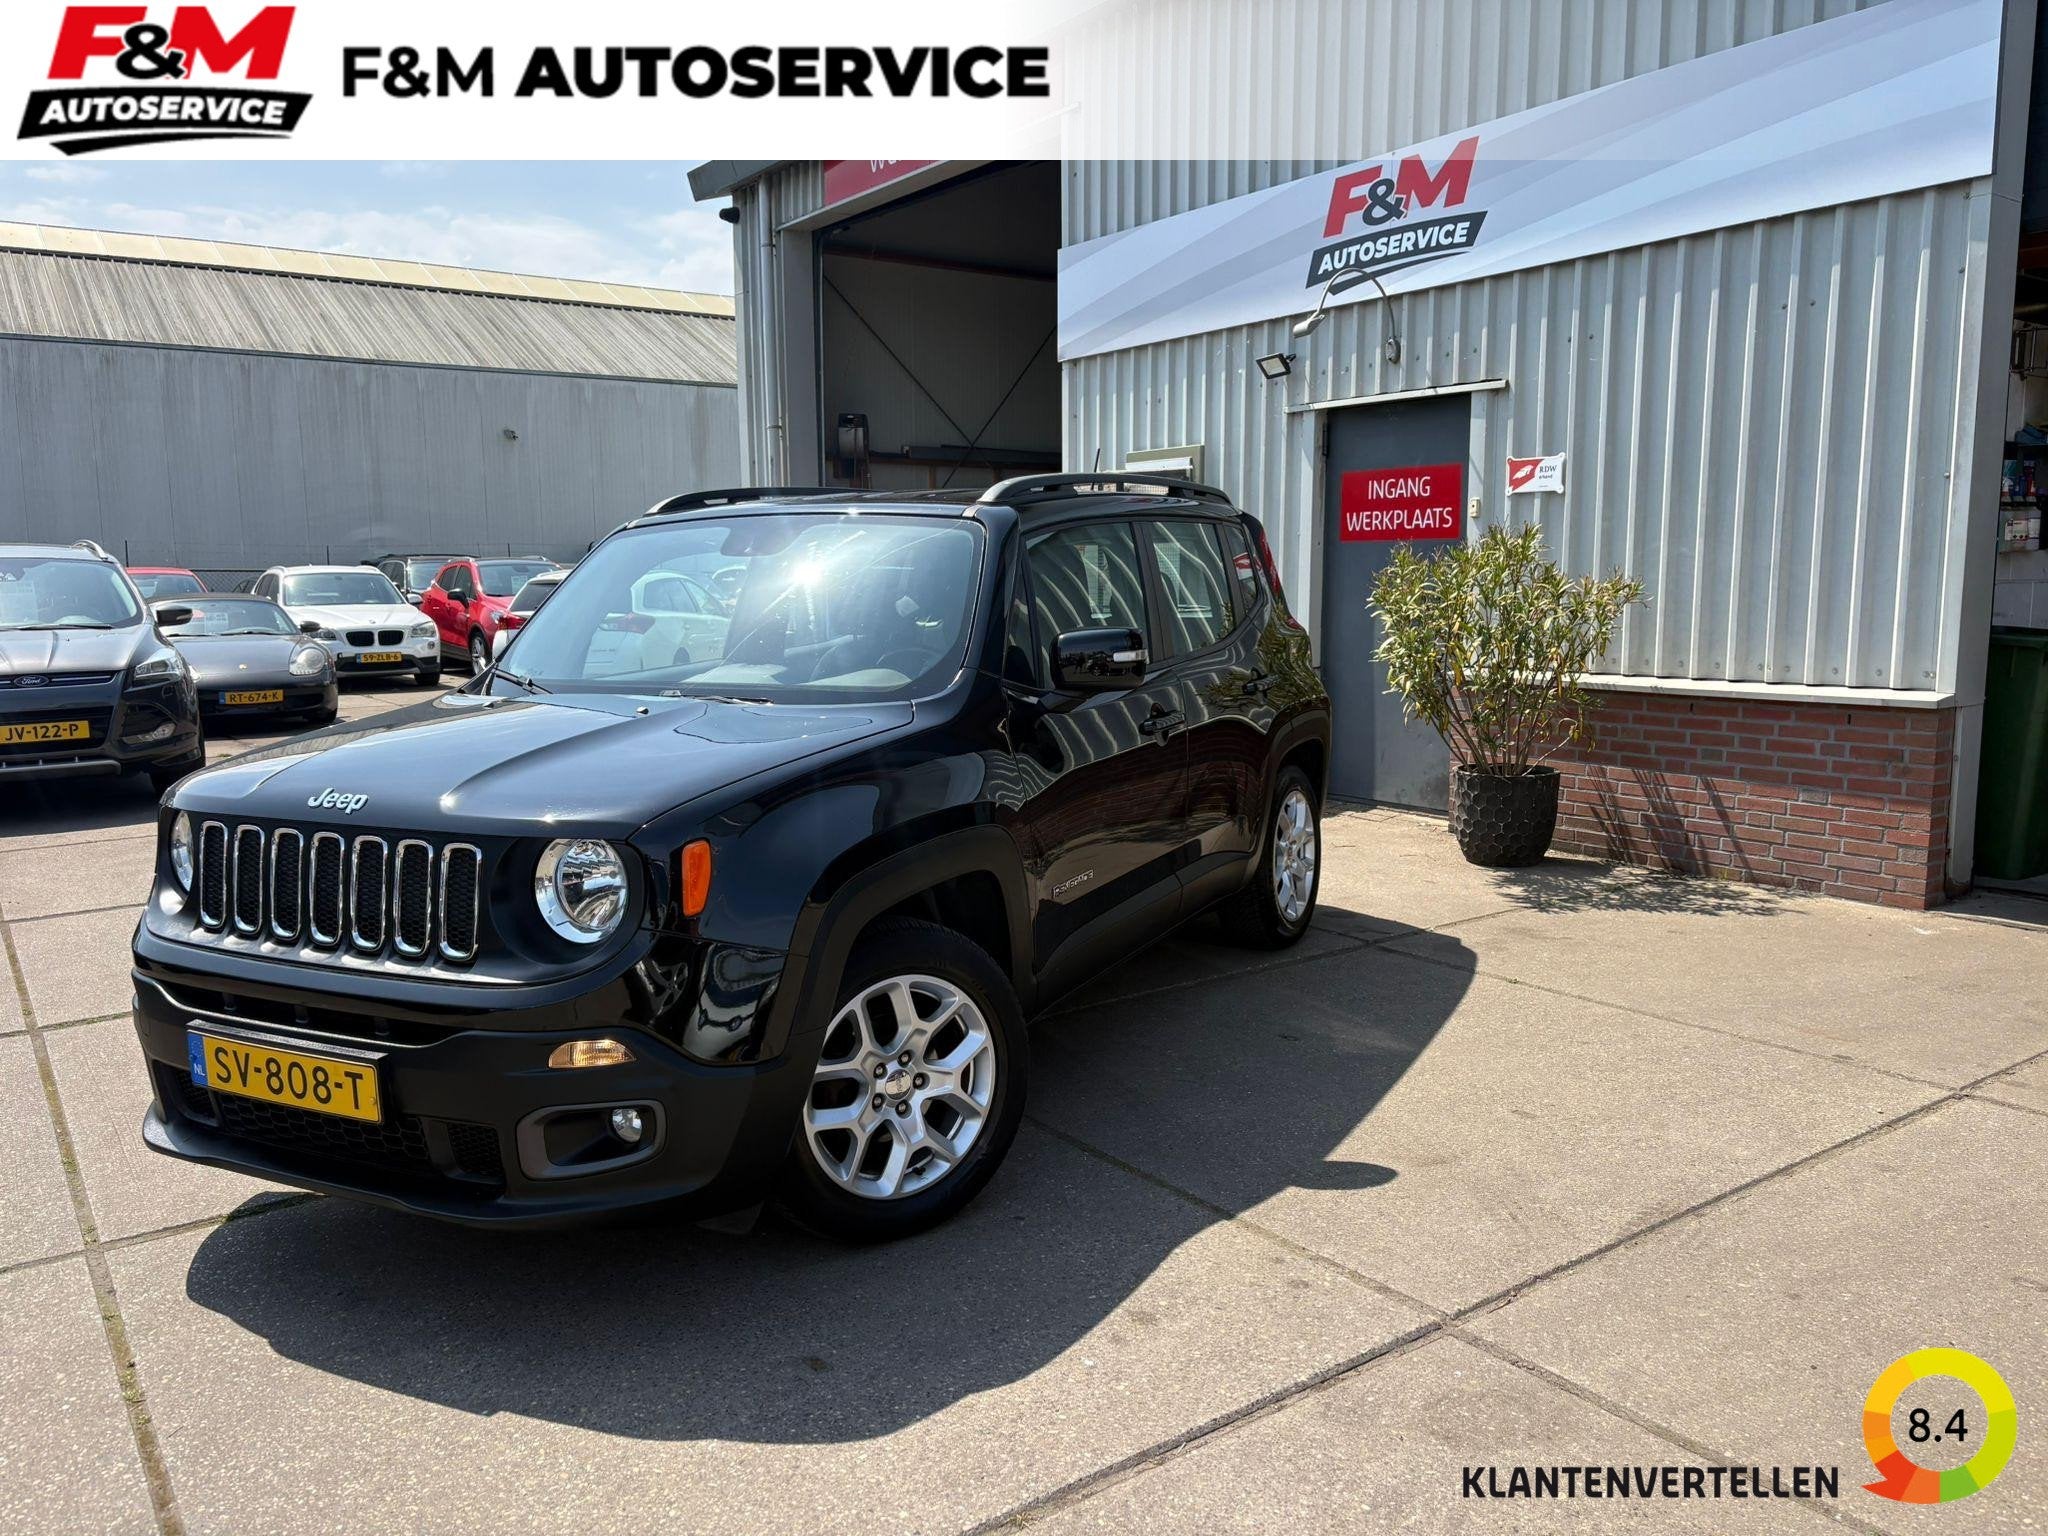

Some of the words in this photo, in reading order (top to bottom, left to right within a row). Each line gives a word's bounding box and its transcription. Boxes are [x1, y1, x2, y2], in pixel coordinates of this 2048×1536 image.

[1323, 136, 1479, 238] F&M
[1317, 221, 1470, 275] AUTOSERVICE
[1539, 465, 1557, 473] RDW
[1368, 476, 1431, 500] INGANG
[1346, 507, 1453, 532] WERKPLAATS
[229, 691, 280, 703] RT-674-K
[5, 723, 79, 741] JV-122-P
[307, 787, 370, 816] Jeep
[193, 1062, 206, 1078] NL
[214, 1046, 364, 1110] SV-808-T
